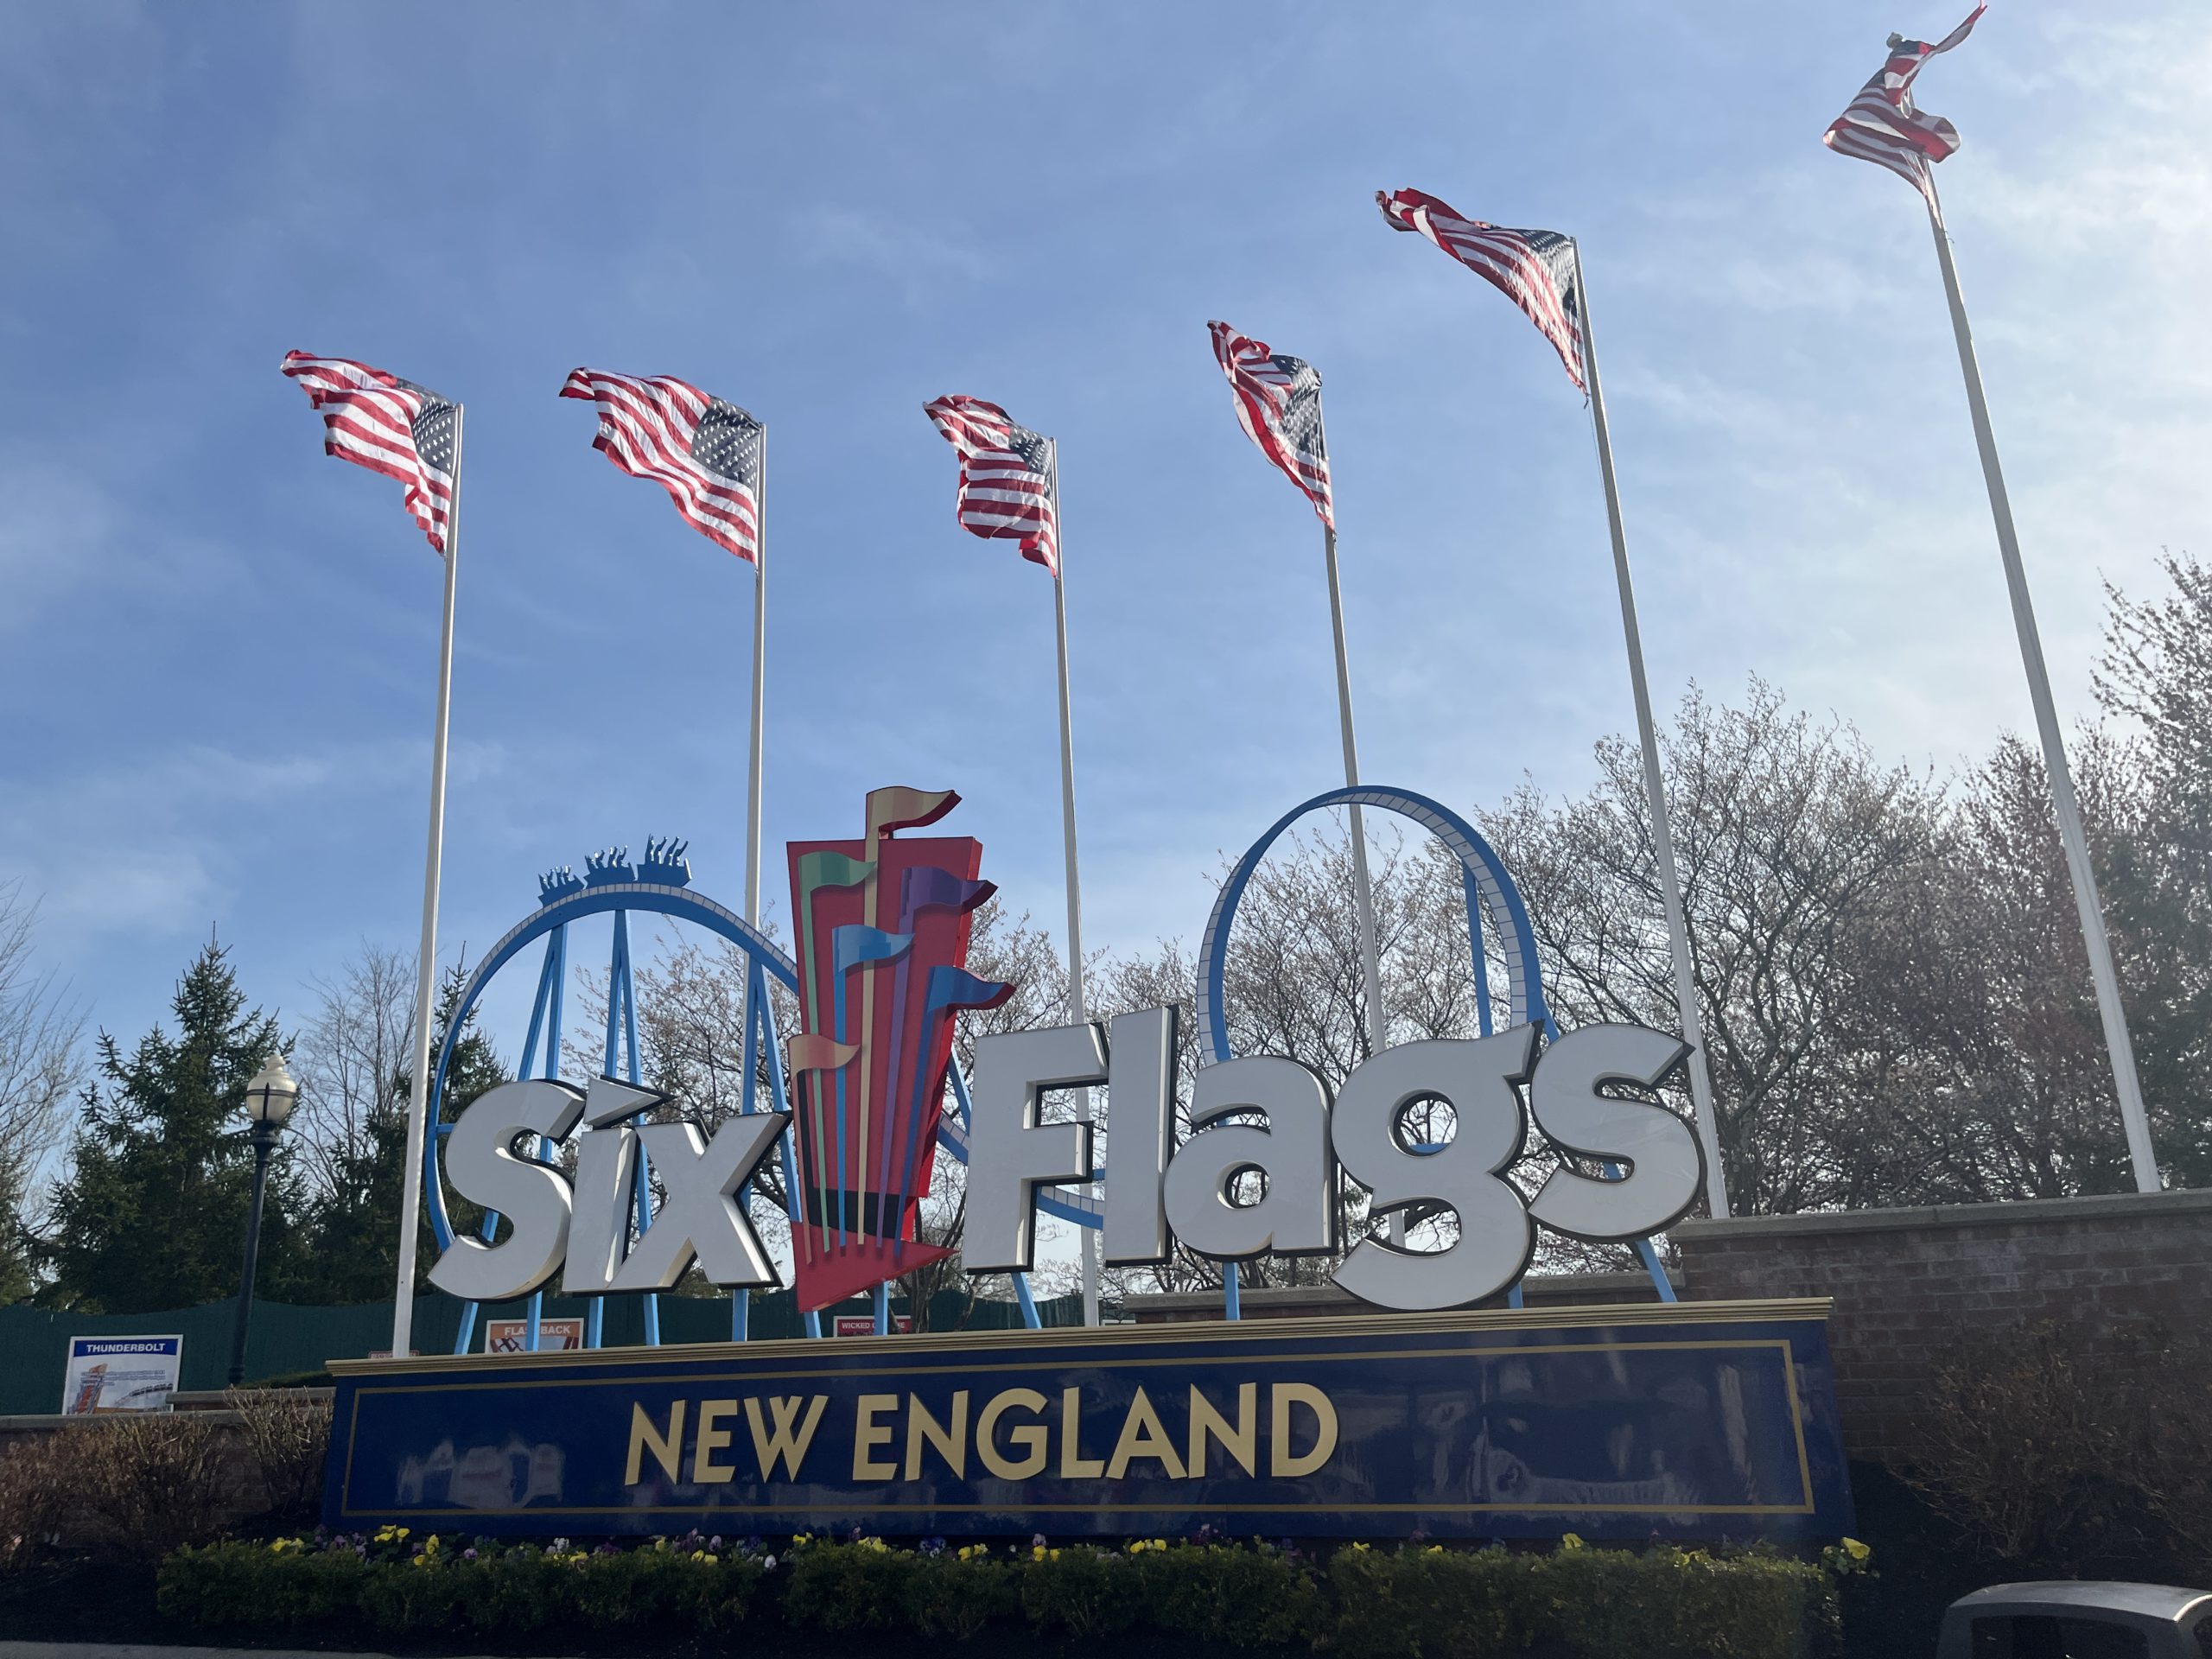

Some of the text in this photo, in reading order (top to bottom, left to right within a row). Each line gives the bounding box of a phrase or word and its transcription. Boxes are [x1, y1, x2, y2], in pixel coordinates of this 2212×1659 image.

[427, 1004, 1706, 1312] Six Flags
[86, 1343, 166, 1353] THUNDERBOLT
[504, 1325, 570, 1336] FLABACK
[624, 1382, 1340, 1486] NEW ENGLAND
